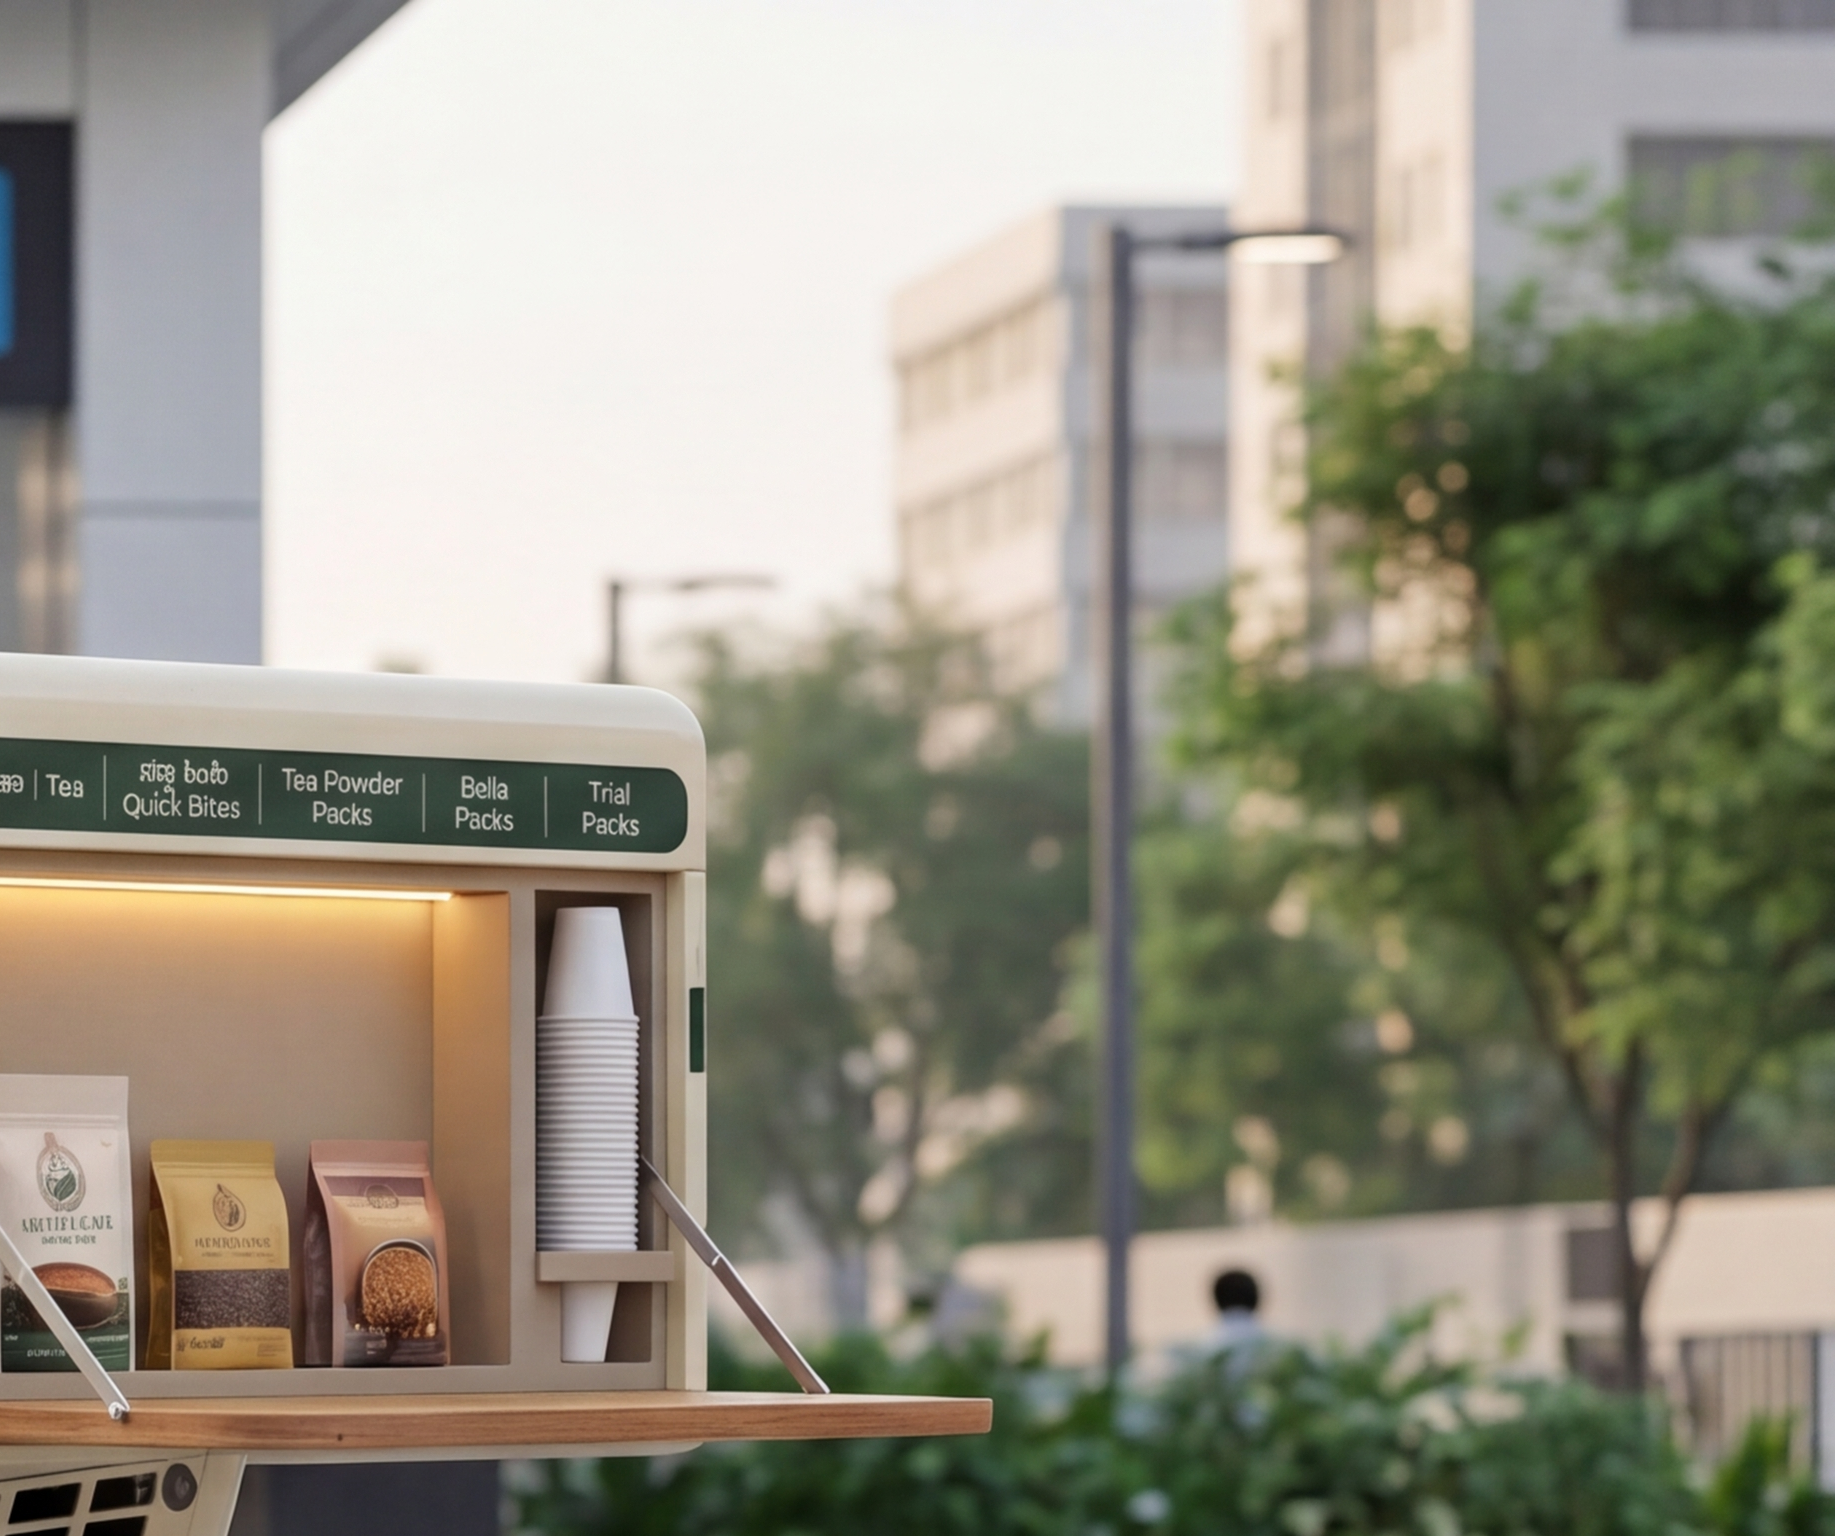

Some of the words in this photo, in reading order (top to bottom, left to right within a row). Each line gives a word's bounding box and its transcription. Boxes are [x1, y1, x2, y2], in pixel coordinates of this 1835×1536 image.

[45, 773, 84, 798] Tea
[281, 767, 318, 792] Tea
[324, 769, 404, 796] Powder
[461, 775, 509, 801] Bella
[588, 780, 631, 806] Trial
[122, 790, 182, 821] Quick
[188, 794, 241, 819] Bites
[312, 800, 373, 826] Packs
[455, 806, 515, 832] Packs
[582, 811, 640, 837] Packs
